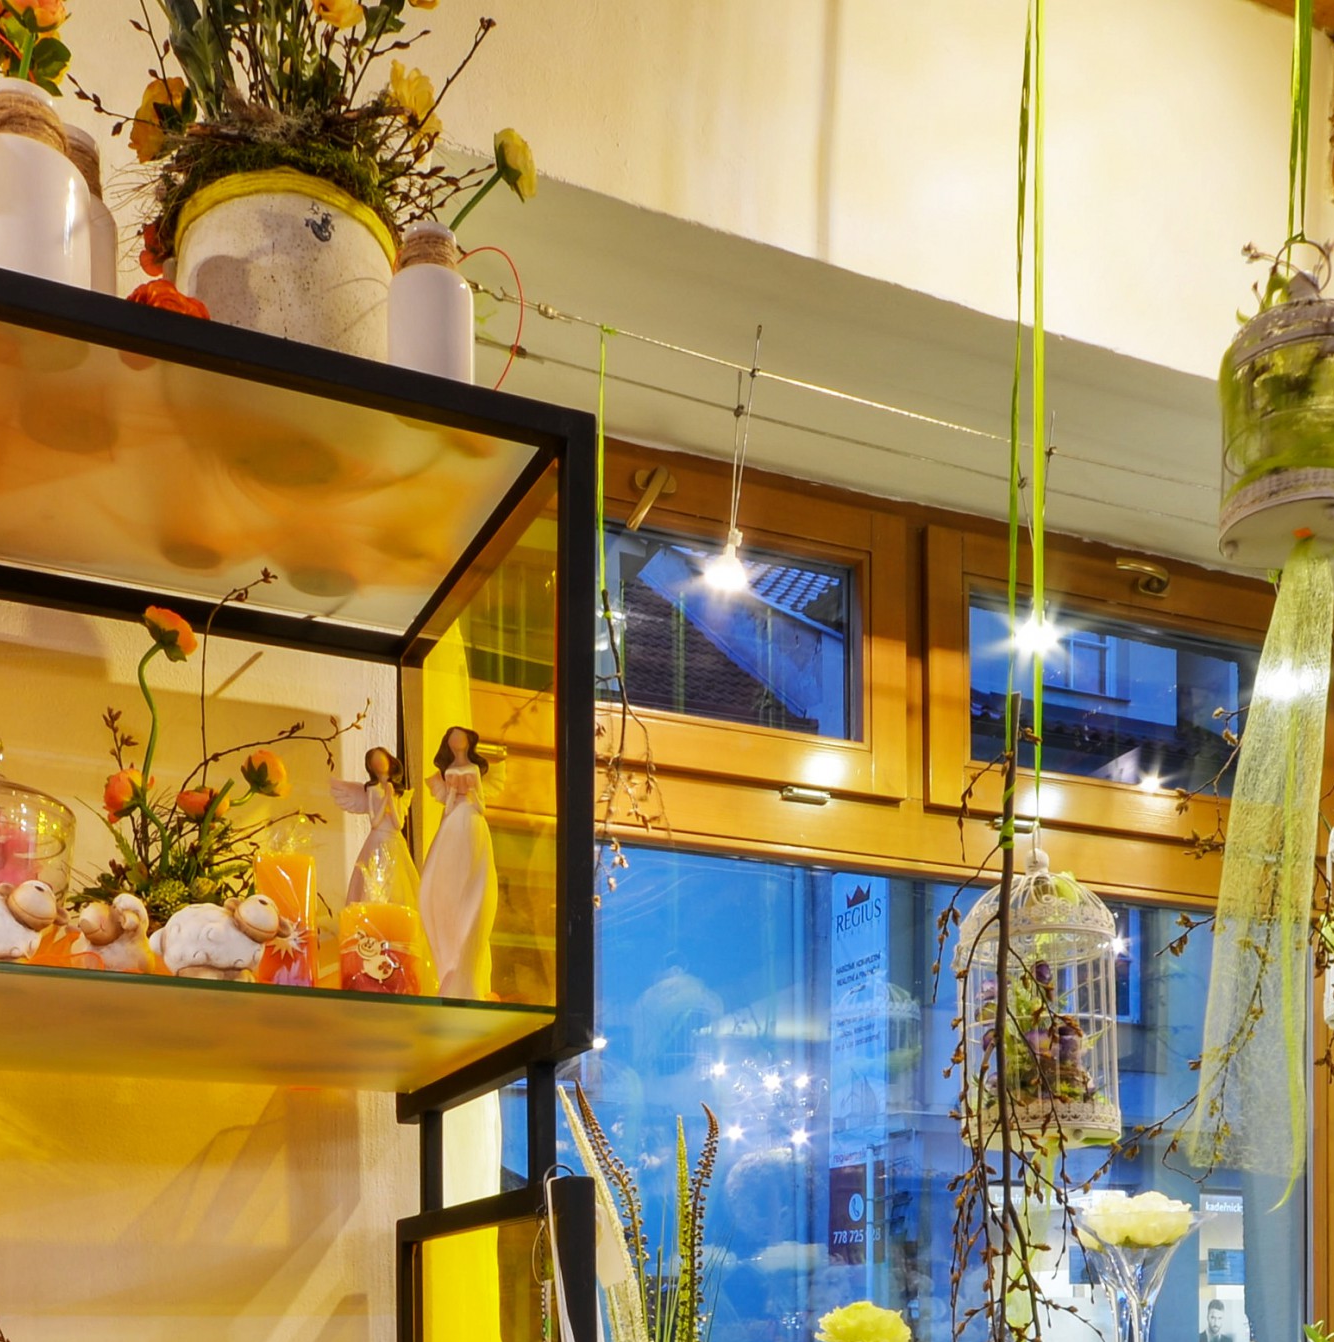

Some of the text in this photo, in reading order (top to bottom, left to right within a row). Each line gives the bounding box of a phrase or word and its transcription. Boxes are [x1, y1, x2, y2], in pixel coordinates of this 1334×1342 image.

[836, 898, 882, 933] REGIUS
[1205, 1201, 1244, 1213] kadeřnick
[833, 1230, 848, 1244] 778
[849, 1229, 864, 1243] 725
